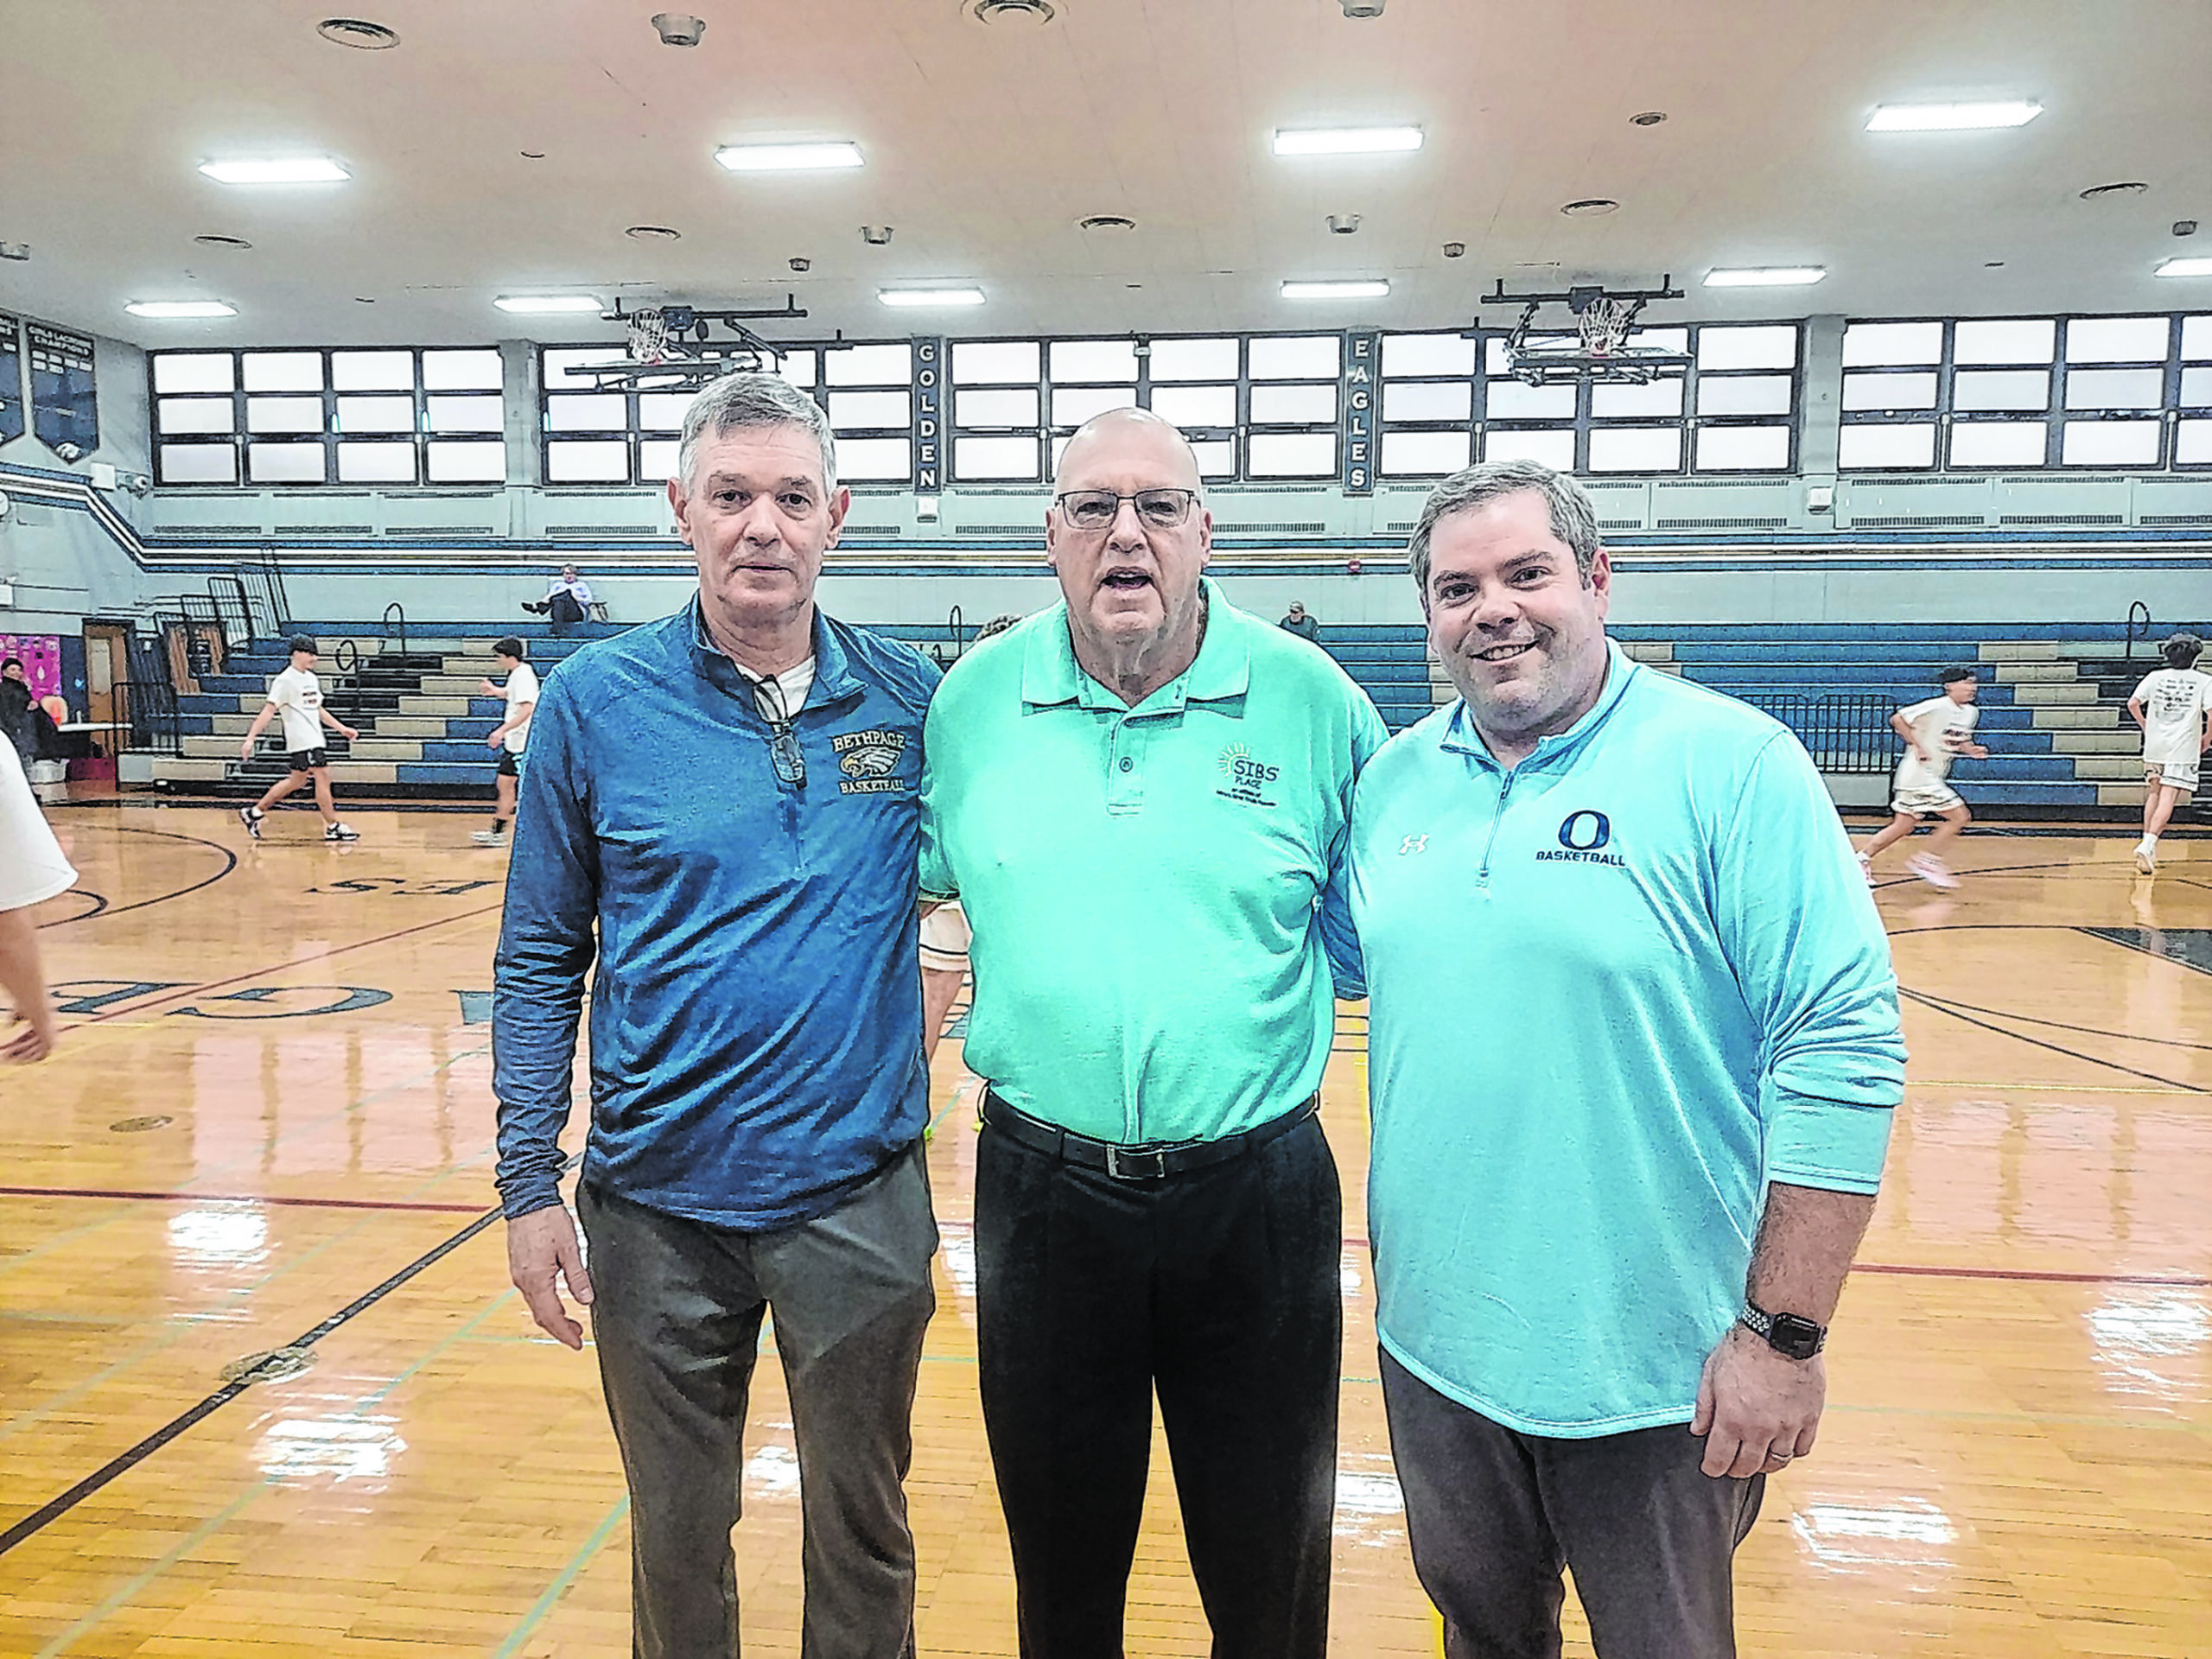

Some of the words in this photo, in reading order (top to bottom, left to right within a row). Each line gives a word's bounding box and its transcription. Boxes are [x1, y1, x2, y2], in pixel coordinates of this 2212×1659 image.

[918, 344, 936, 487] GOLDEN
[1351, 340, 1370, 487] EAGLES
[833, 730, 906, 753] BETHPAGE
[1234, 760, 1280, 782] SIBS
[840, 779, 906, 794] BASKETBALL
[1558, 810, 1611, 850] O
[1535, 850, 1626, 867] BASKETBALL
